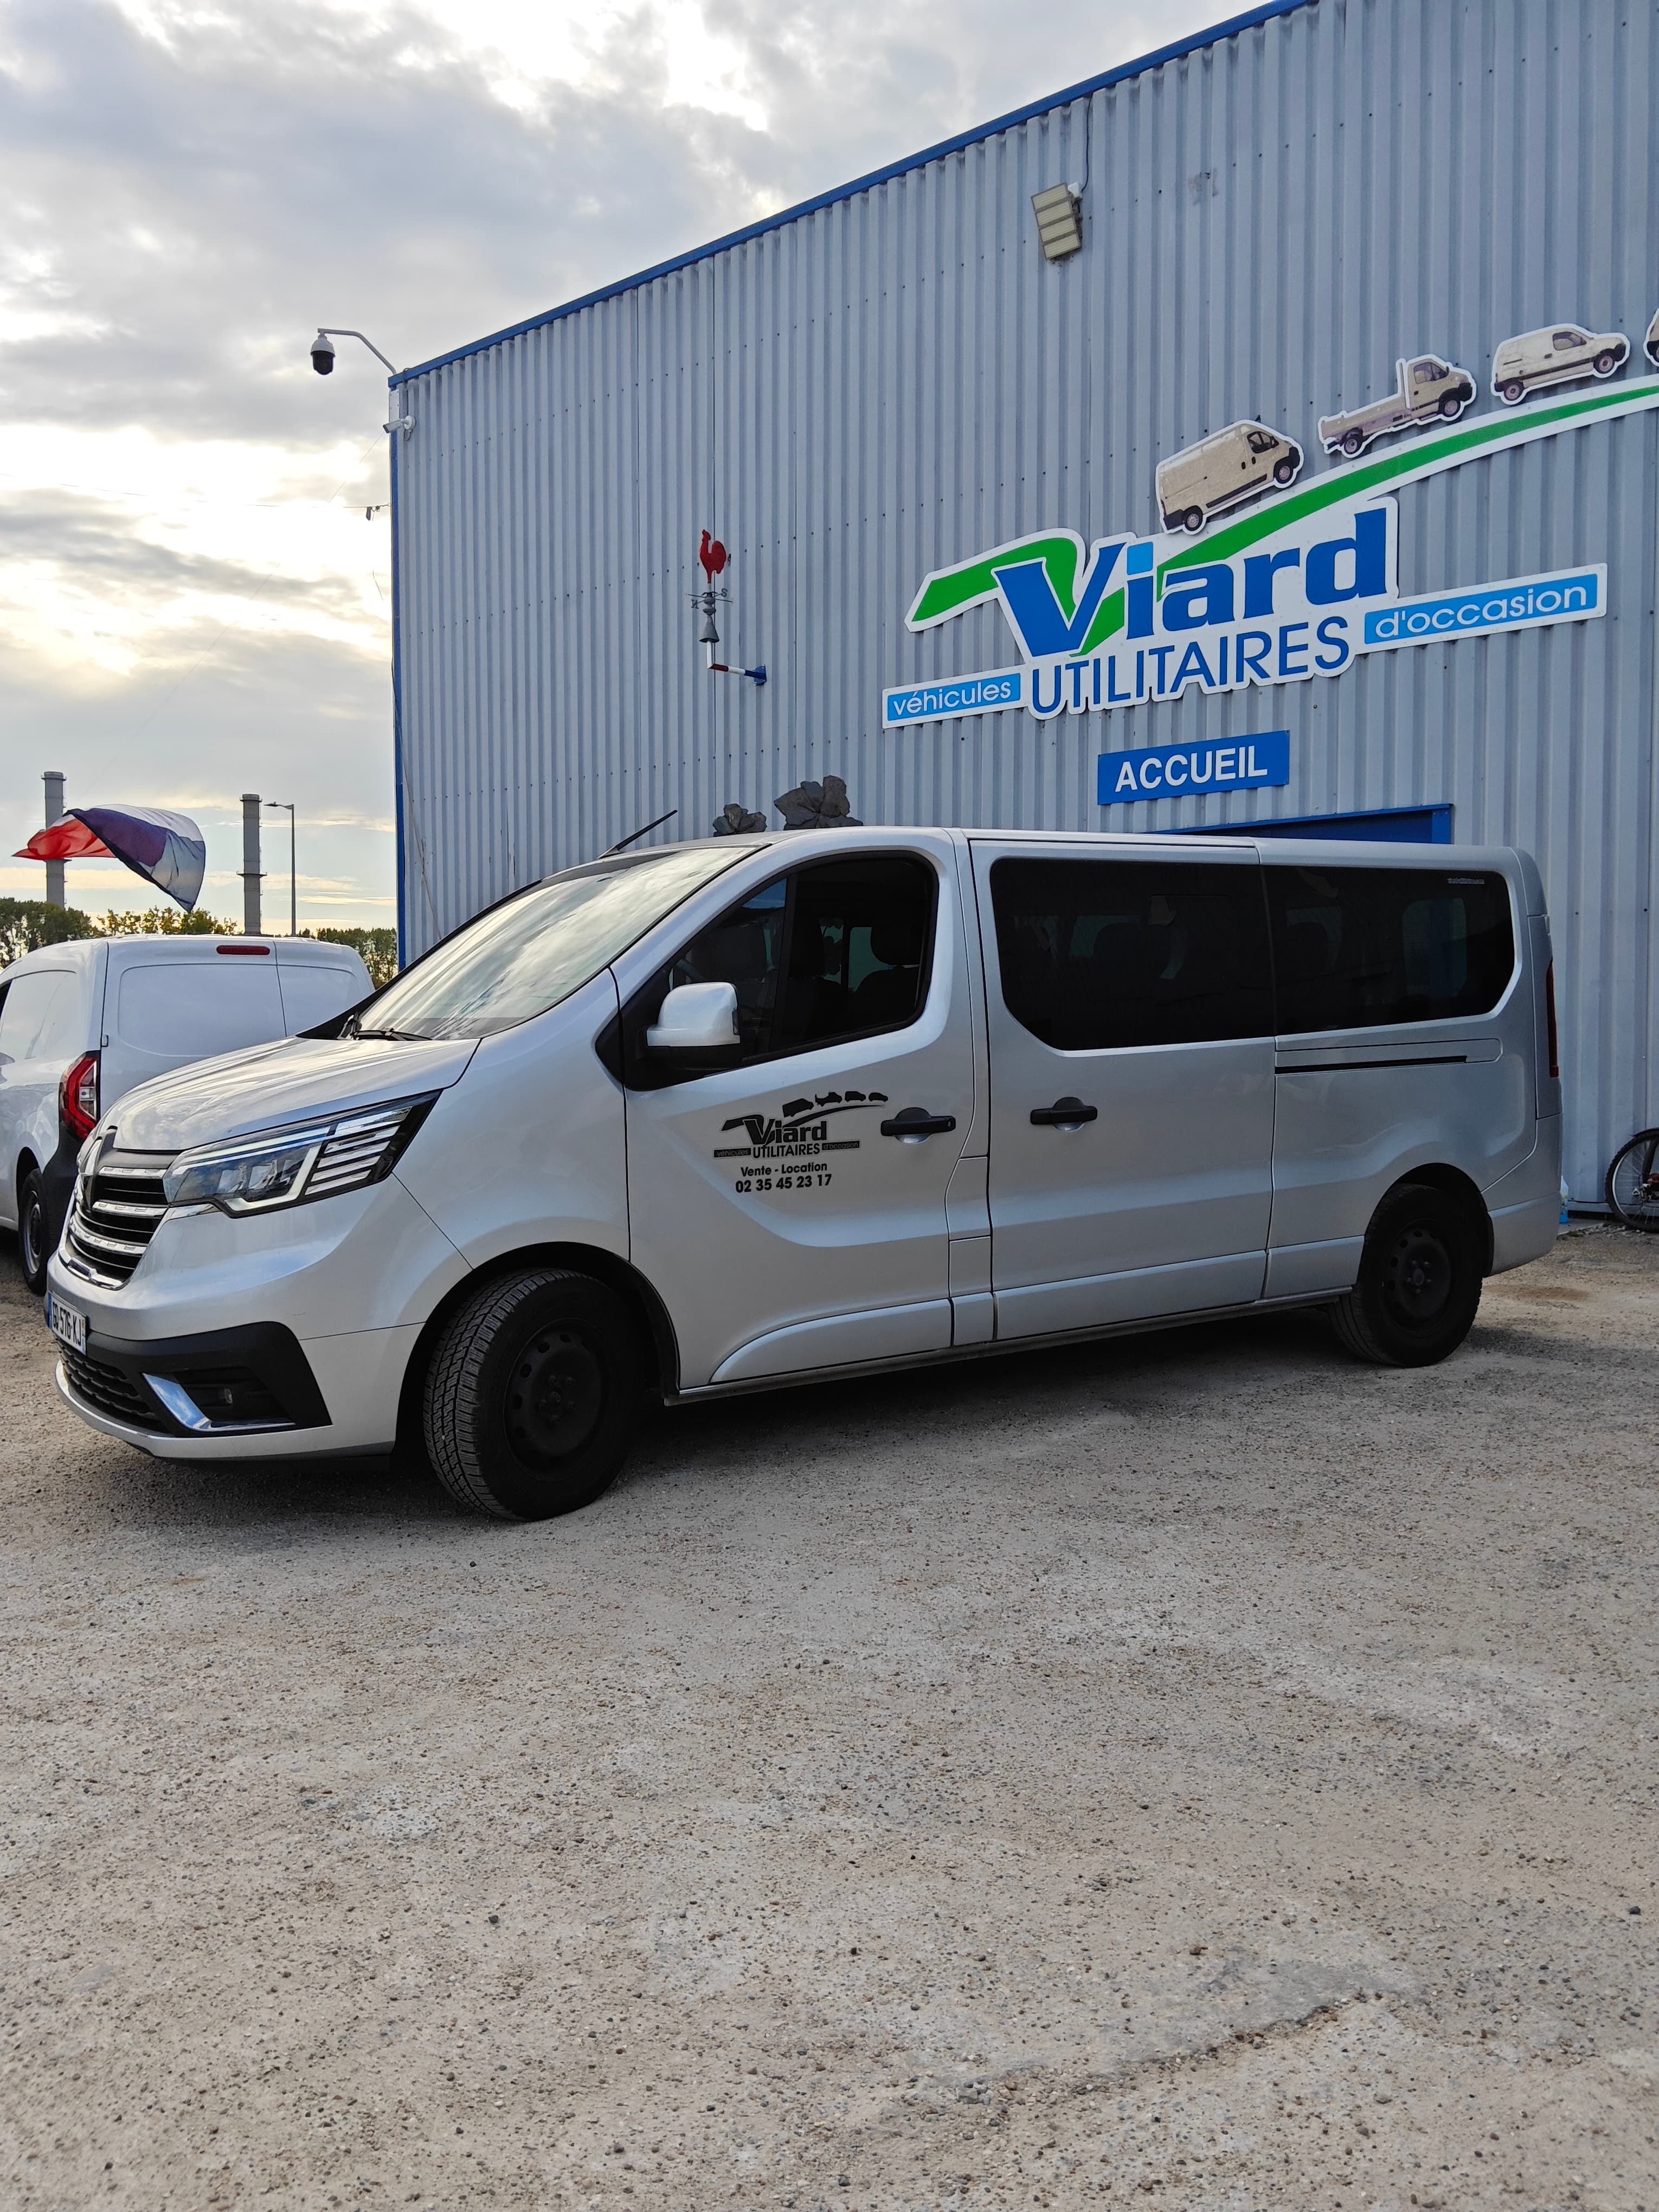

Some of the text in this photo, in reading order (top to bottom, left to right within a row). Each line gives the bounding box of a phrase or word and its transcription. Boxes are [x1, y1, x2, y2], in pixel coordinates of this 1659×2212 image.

[994, 507, 1387, 657] Viard
[893, 585, 1587, 716] véhicules UTILITAIRES d'occasion
[1115, 745, 1268, 793] ACCUEIL
[743, 1118, 827, 1145] Viard
[716, 1141, 859, 1159] véhicules UTILITAIRES d'occasion
[735, 1173, 832, 1193] 02 35 45 23 17
[741, 1165, 772, 1177] Vente
[781, 1162, 827, 1174] Location
